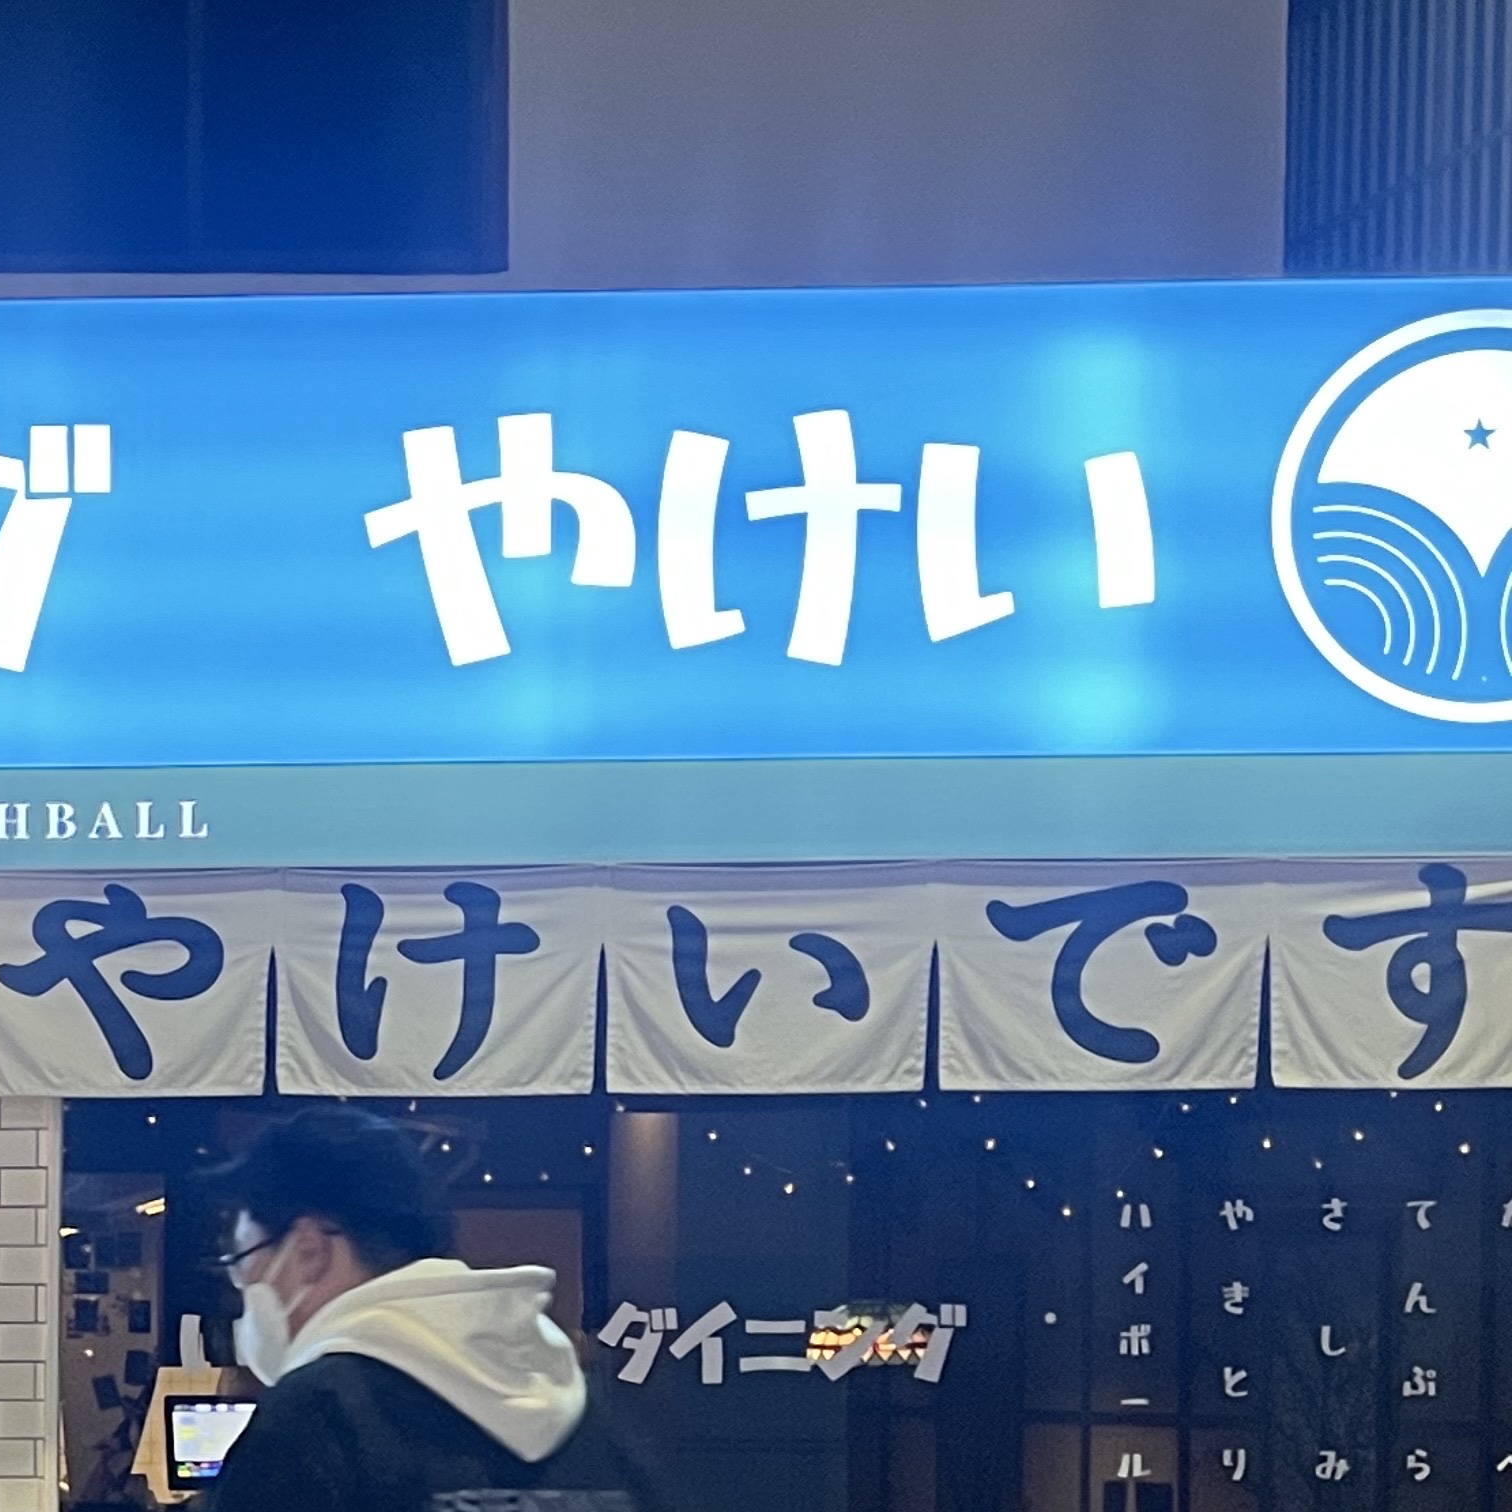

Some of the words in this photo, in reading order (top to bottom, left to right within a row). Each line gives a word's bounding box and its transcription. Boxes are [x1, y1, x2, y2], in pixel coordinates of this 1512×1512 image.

[363, 408, 1156, 667] やけい
[597, 1301, 967, 1384] ダイニング
[1117, 1203, 1152, 1478] ハイボール
[1219, 1198, 1254, 1481] やきとり
[1315, 1198, 1350, 1481] さしみ
[1402, 1200, 1437, 1481] てんぷら
